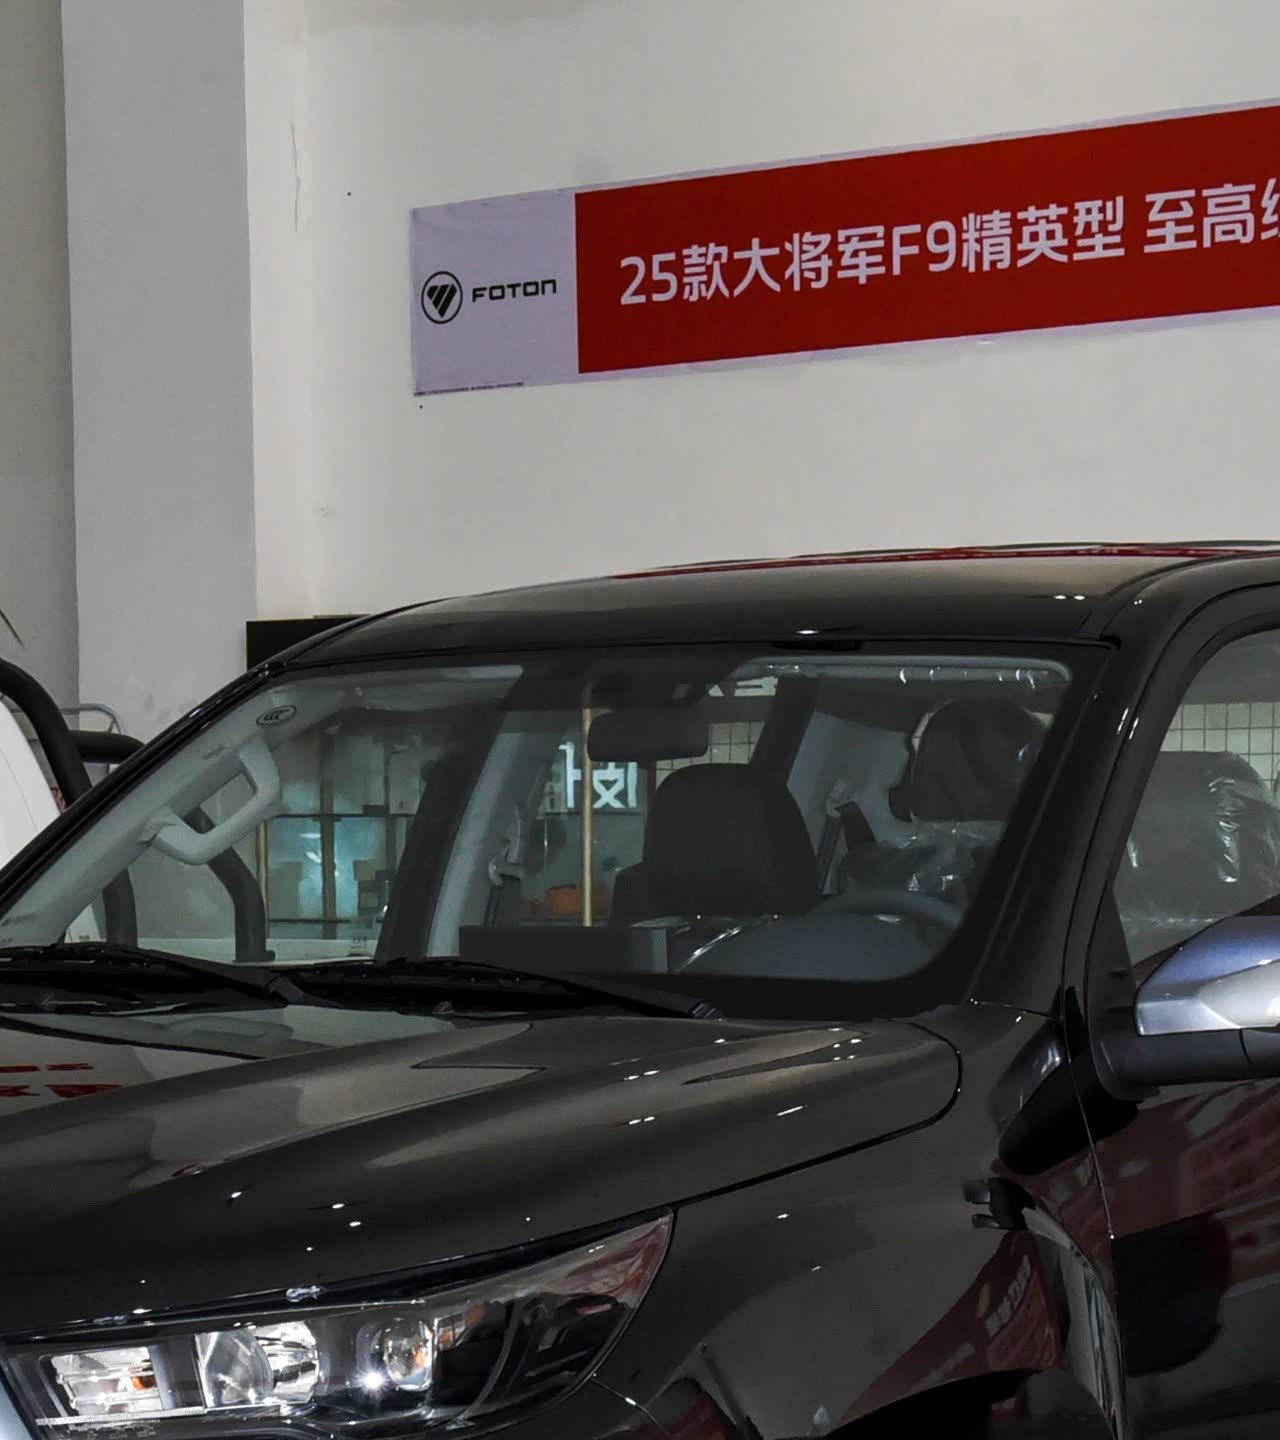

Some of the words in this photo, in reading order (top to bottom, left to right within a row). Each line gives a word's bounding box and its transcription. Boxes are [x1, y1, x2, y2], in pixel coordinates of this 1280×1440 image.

[620, 195, 1126, 306] 25款大将军F9精英型
[472, 278, 557, 304] FOTON
